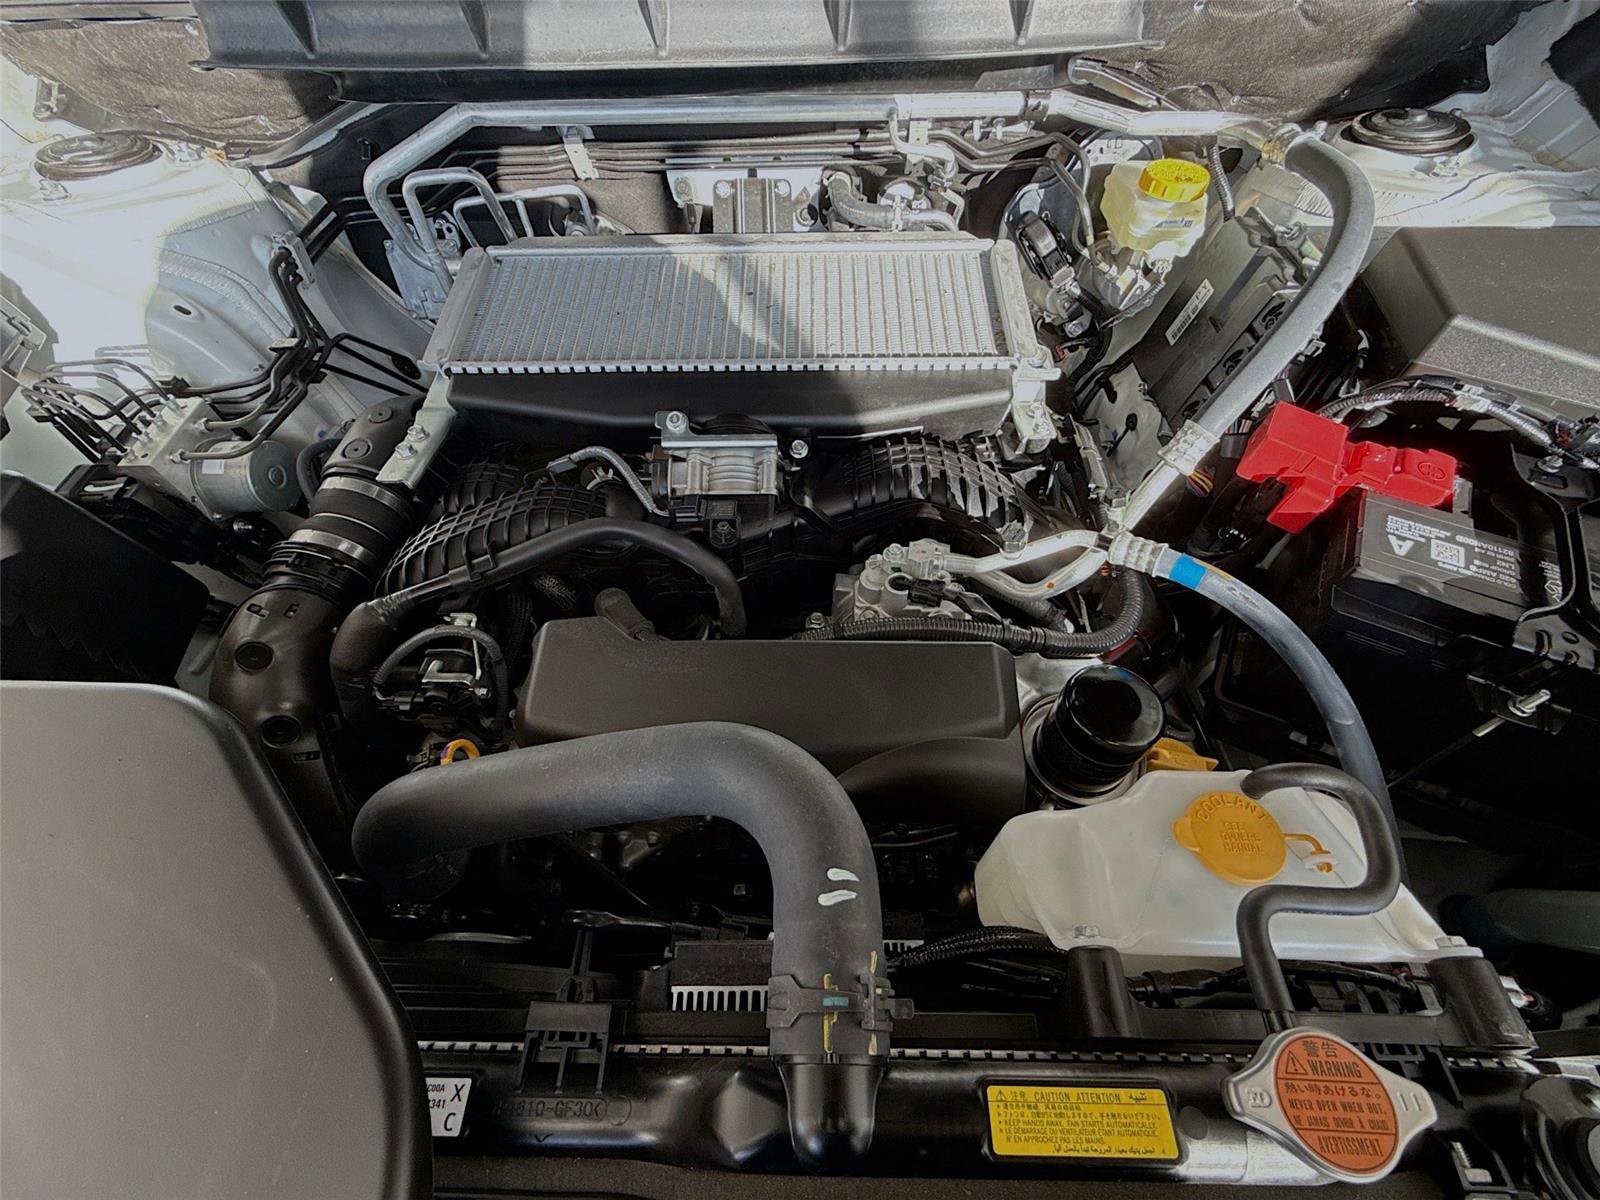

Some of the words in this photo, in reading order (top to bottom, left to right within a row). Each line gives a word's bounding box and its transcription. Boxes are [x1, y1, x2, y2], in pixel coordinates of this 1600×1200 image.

[1196, 794, 1267, 821] COOLANT
[1307, 1060, 1363, 1079] WARNING
[451, 1084, 465, 1102] X
[1034, 1091, 1071, 1102] CAUTION
[1077, 1092, 1120, 1103] ATTENTION
[1288, 1099, 1315, 1111] NEVER
[1316, 1100, 1338, 1112] OPEN
[1340, 1101, 1365, 1114] WHEN
[444, 1112, 456, 1132] C
[1067, 1120, 1080, 1128] FAN
[1081, 1120, 1104, 1128] STARTS
